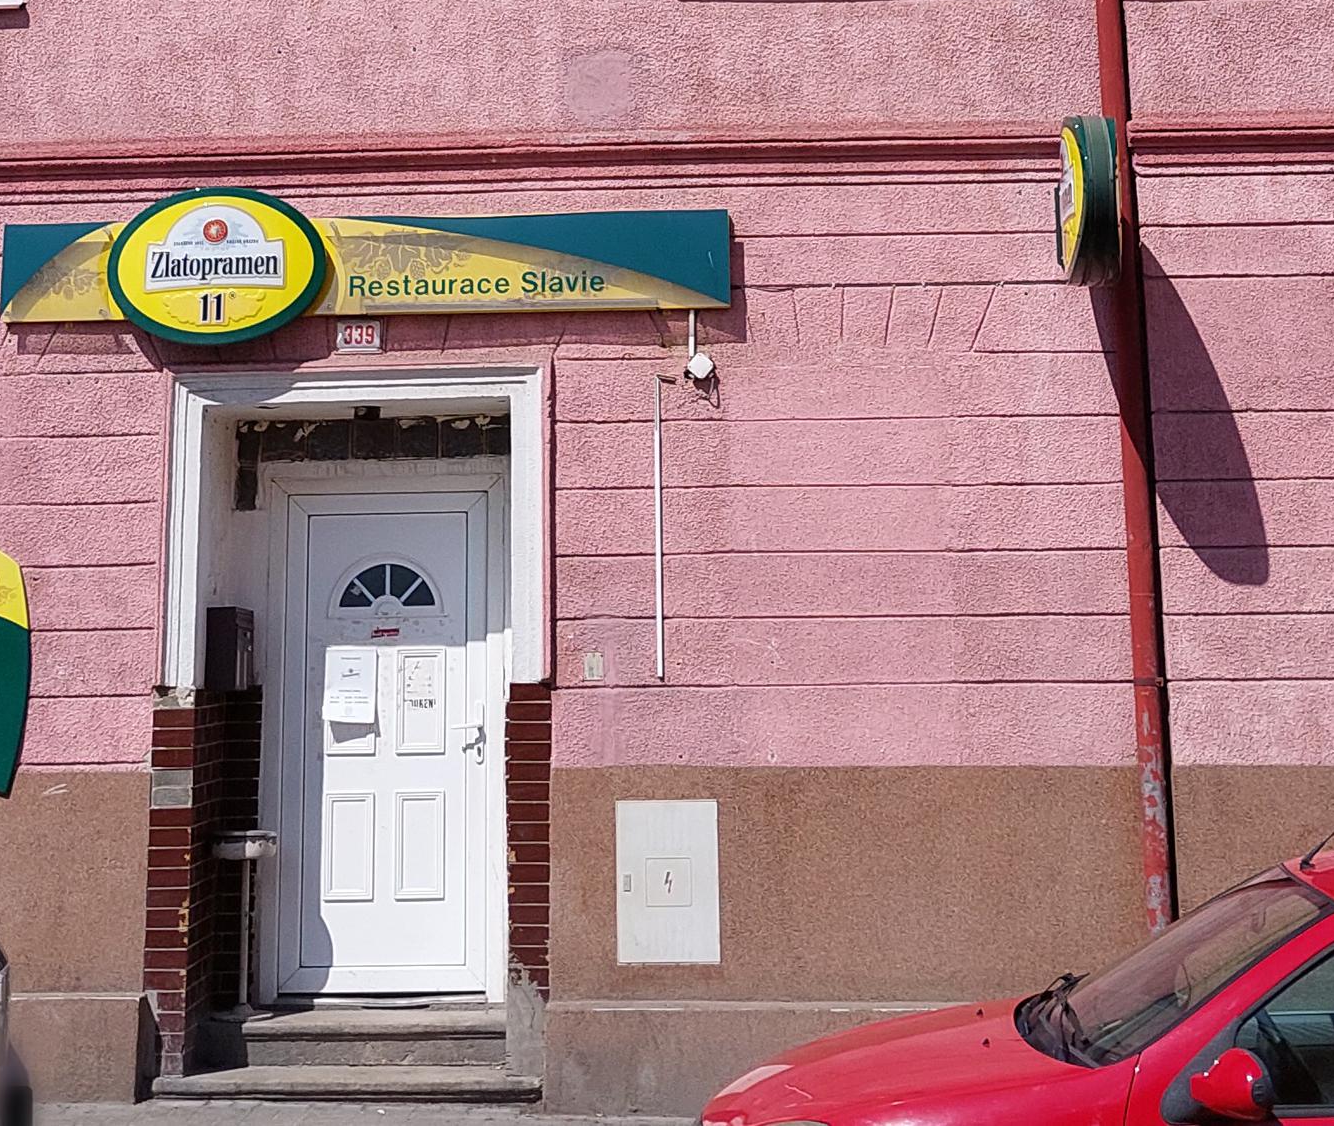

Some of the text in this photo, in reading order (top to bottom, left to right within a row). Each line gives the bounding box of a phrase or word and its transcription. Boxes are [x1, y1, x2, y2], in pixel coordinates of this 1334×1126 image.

[151, 251, 278, 281] Zlatopramen
[348, 270, 605, 297] Restaurace Slavie
[199, 293, 222, 322] 11
[343, 324, 375, 345] 339
